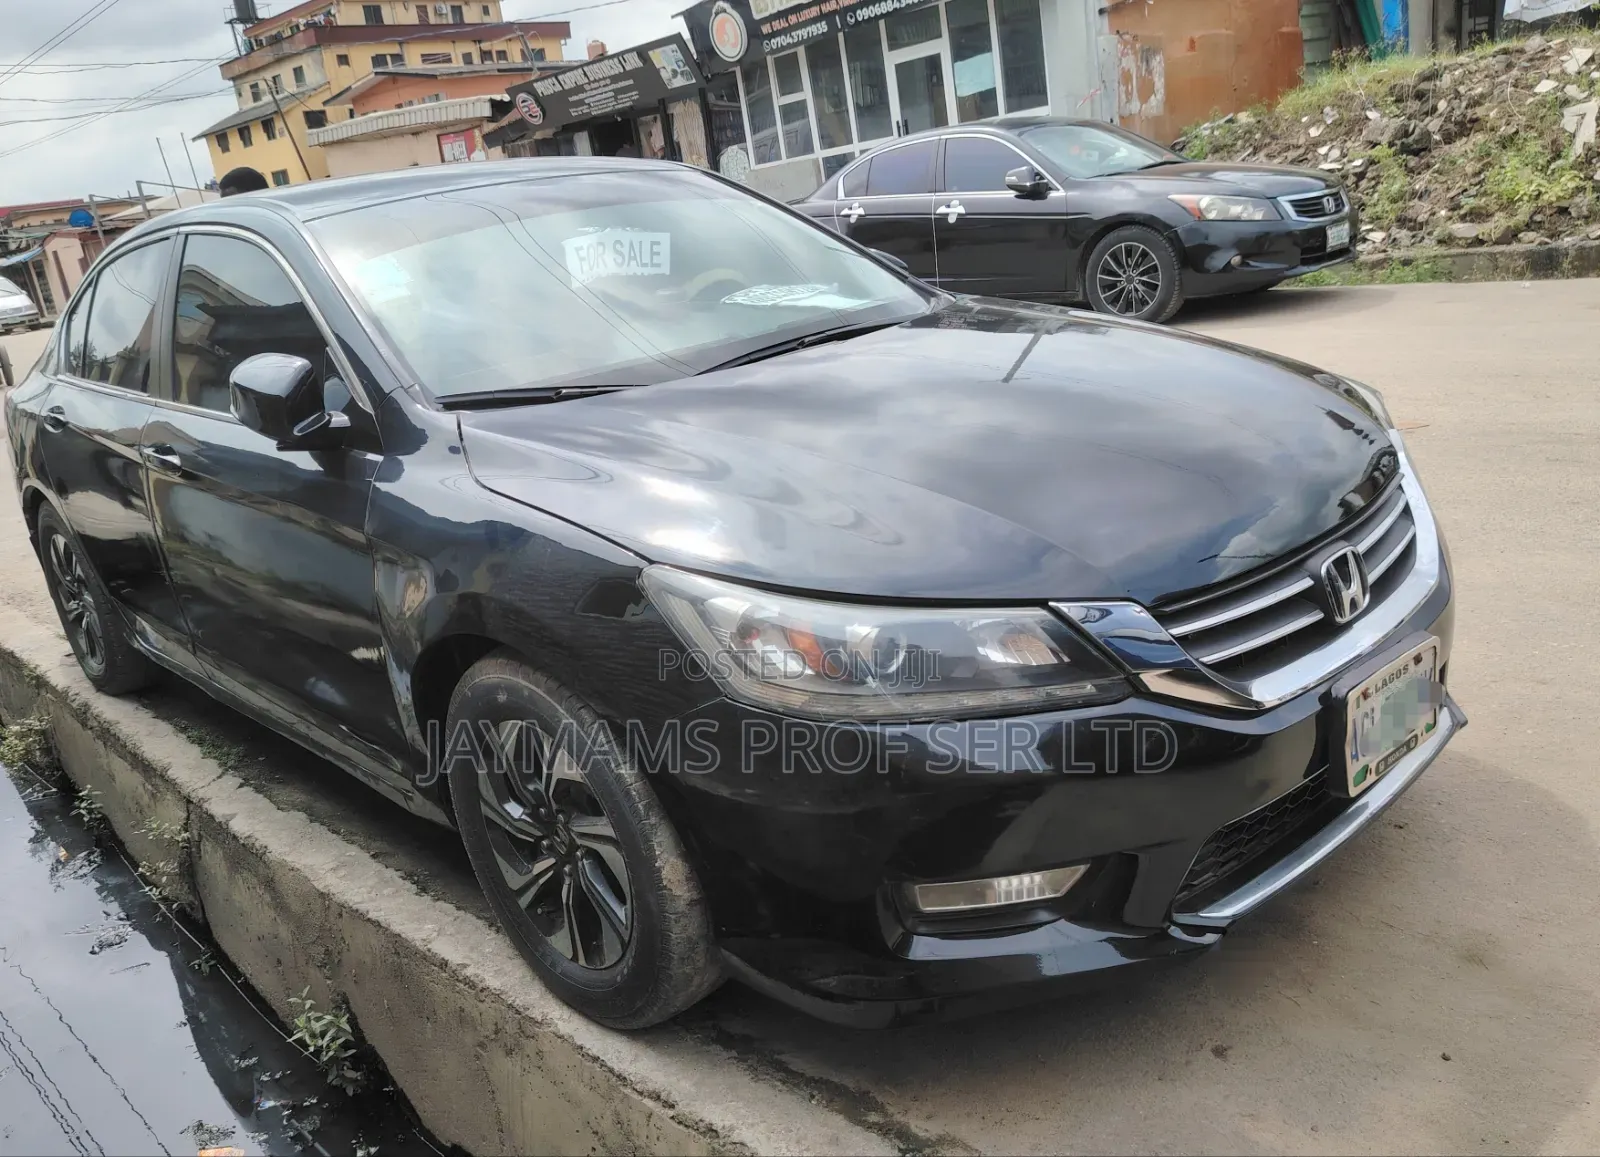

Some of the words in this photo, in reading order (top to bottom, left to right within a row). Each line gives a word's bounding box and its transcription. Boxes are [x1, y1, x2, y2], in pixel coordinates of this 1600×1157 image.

[761, 23, 772, 35] WE
[772, 18, 789, 31] DEAL
[788, 14, 798, 25] ON
[797, 5, 820, 22] LUXURY
[770, 20, 828, 48] 07043797935
[583, 57, 624, 81] BUSINESS
[574, 241, 607, 275] FOR
[612, 239, 662, 268] SALE
[1374, 663, 1409, 694] LAGOS
